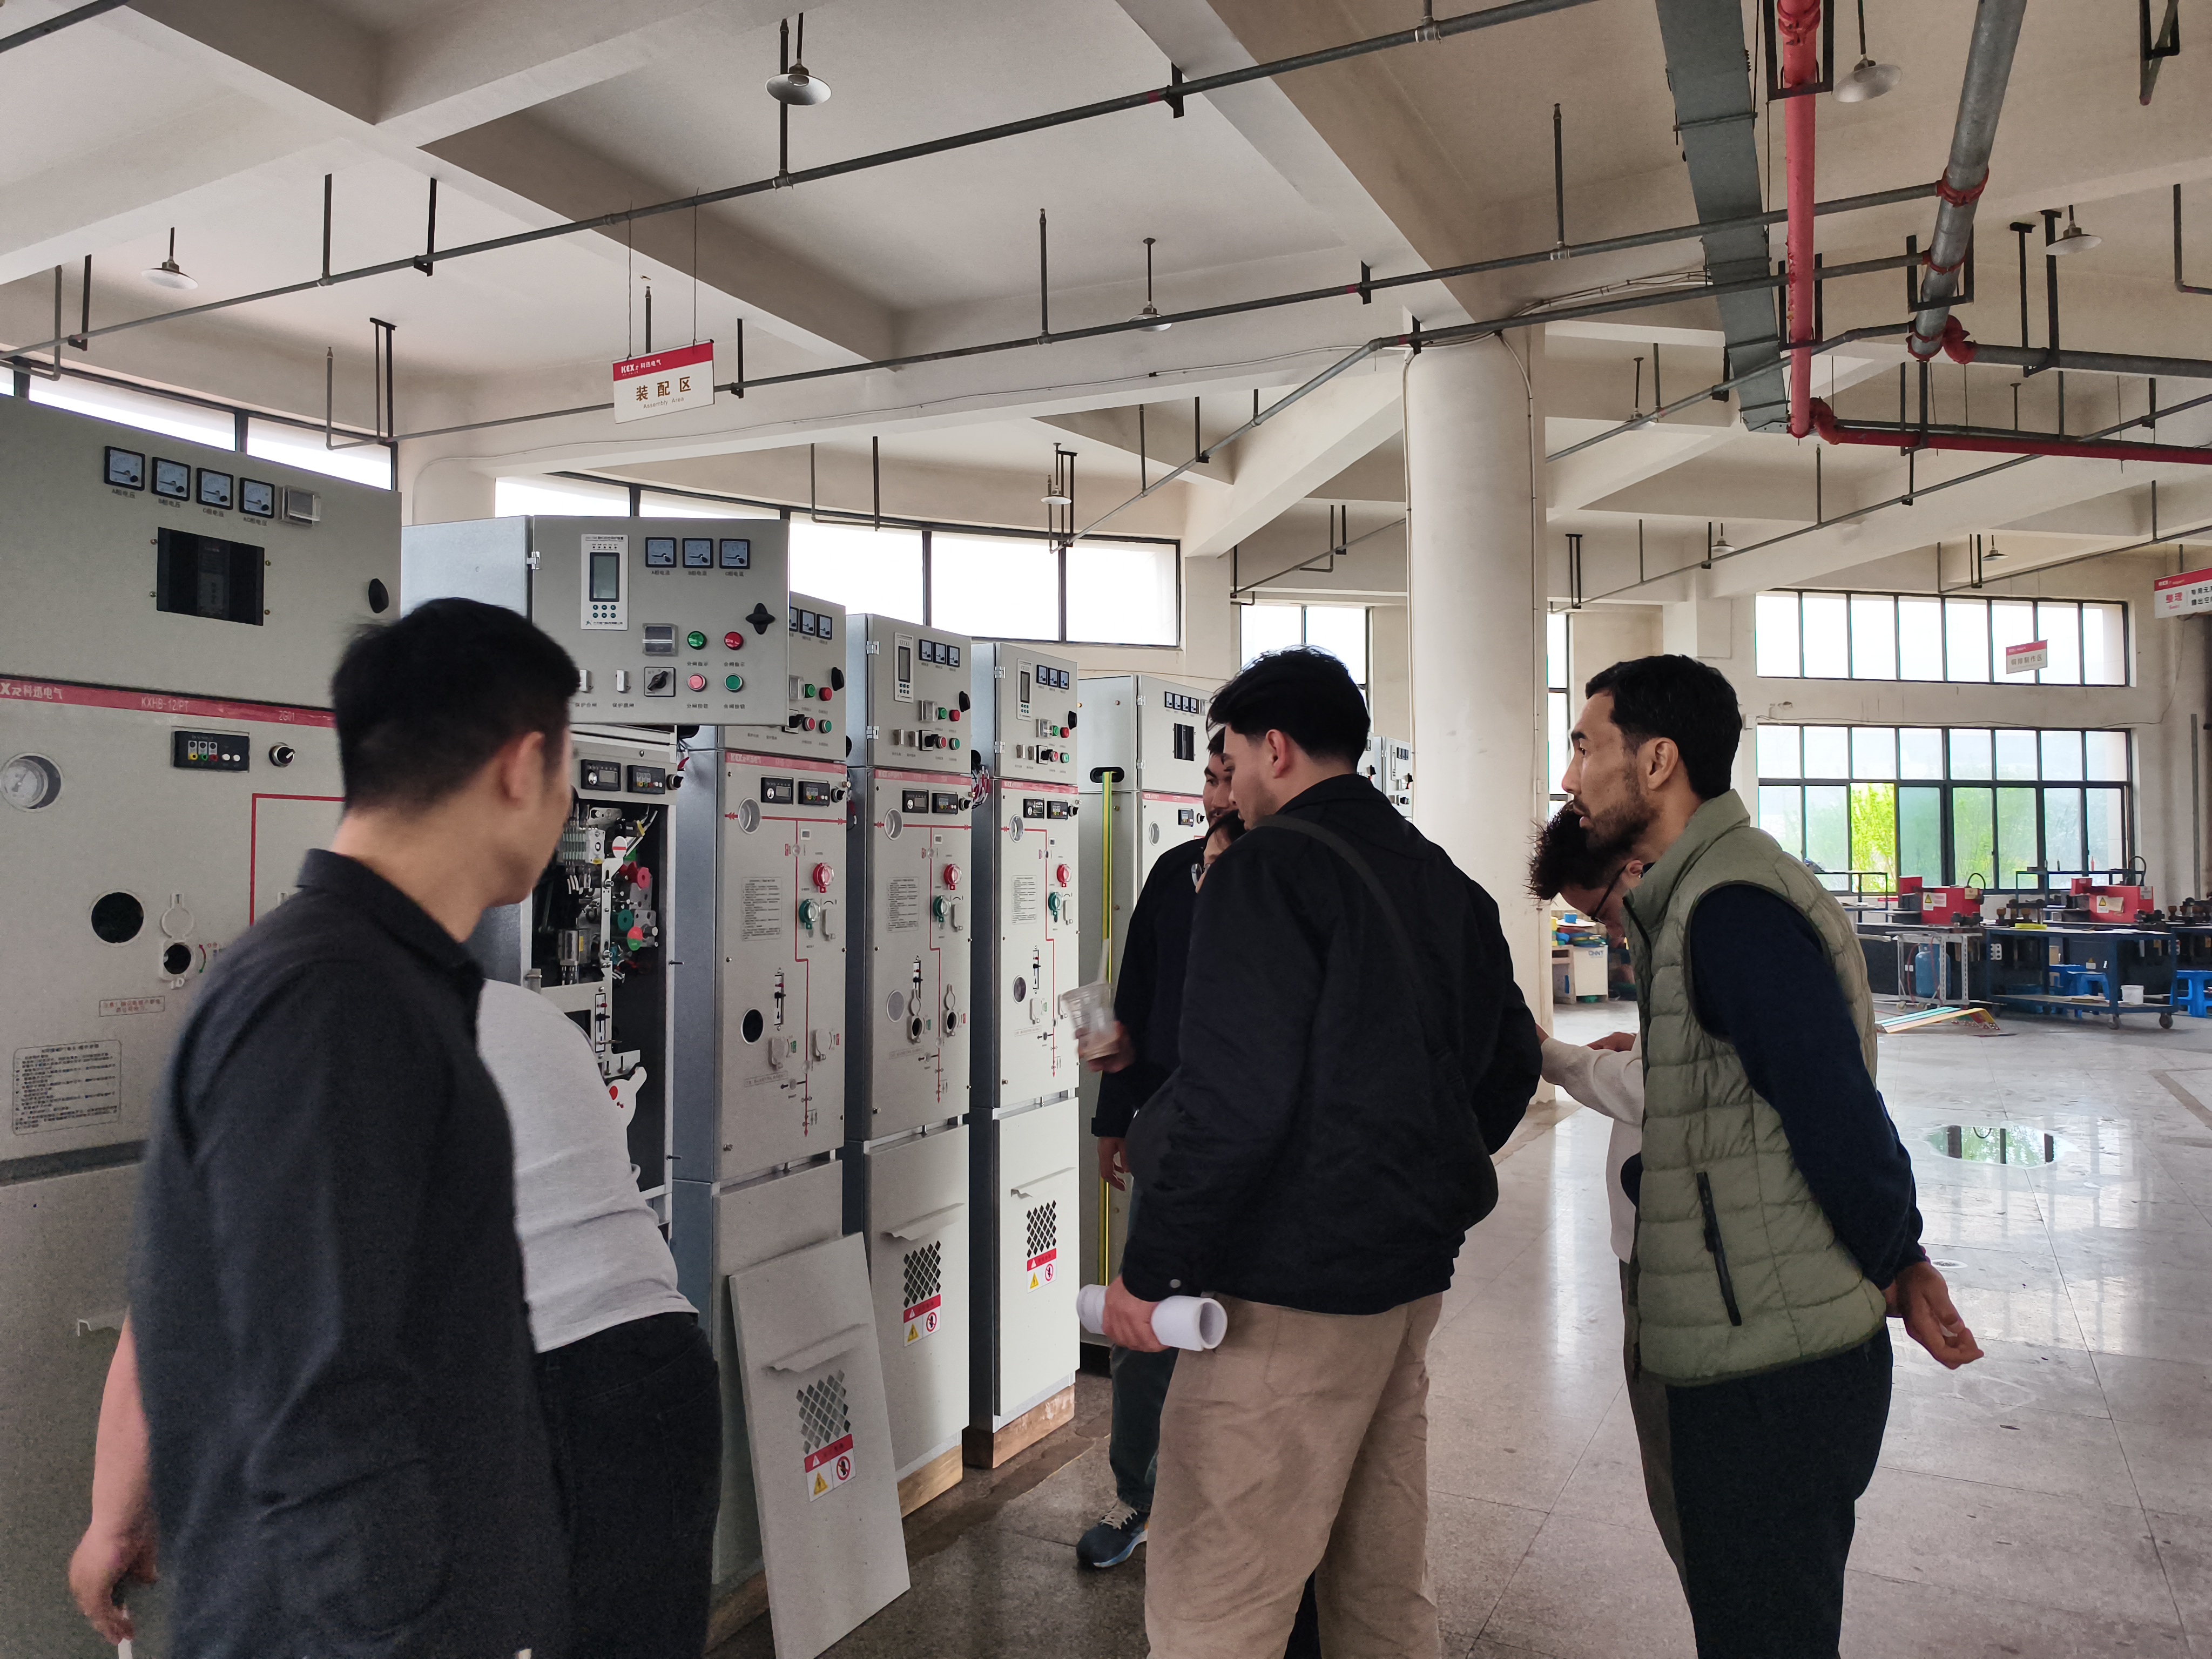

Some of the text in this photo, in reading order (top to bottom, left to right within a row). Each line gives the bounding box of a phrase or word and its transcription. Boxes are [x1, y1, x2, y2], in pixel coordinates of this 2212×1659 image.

[636, 376, 691, 401] 装配区
[643, 400, 668, 409] Assembly
[23, 684, 63, 700] 科迅电气
